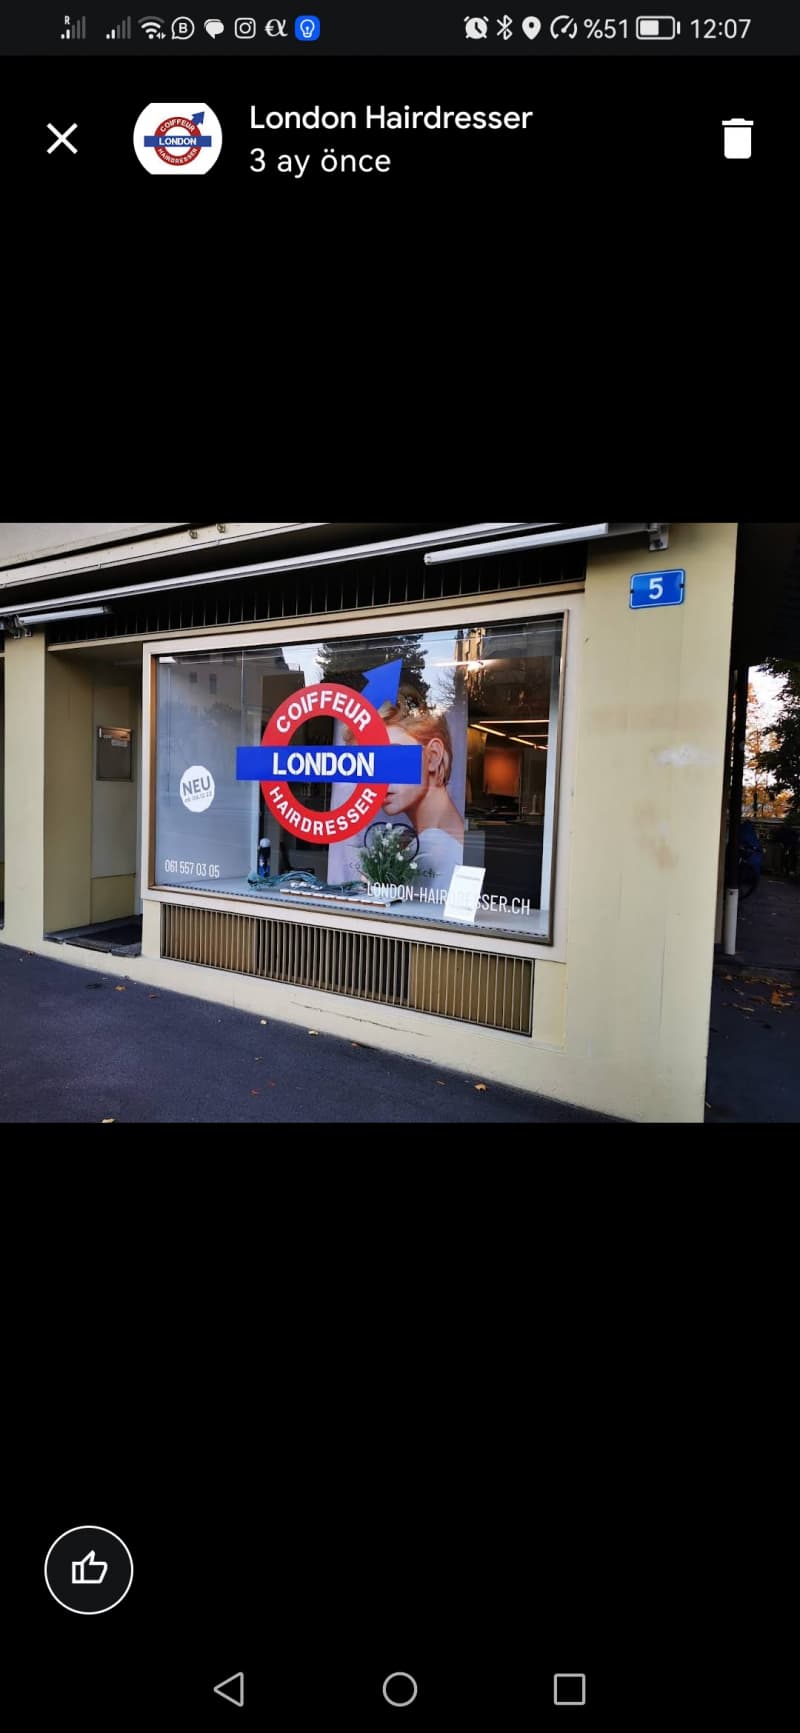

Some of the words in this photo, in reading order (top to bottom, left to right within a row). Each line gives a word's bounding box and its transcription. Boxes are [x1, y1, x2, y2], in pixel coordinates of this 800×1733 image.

[648, 577, 664, 600] 5
[276, 690, 372, 734] COIFFEUR
[272, 751, 376, 777] LONDON
[182, 775, 211, 797] NEU
[269, 785, 379, 837] HAIRDRESSER
[164, 859, 178, 873] 061
[179, 861, 194, 874] 557
[196, 863, 207, 876] 03
[208, 864, 220, 878] 05
[366, 881, 531, 916] LONDON-HAIRSSER.CH
